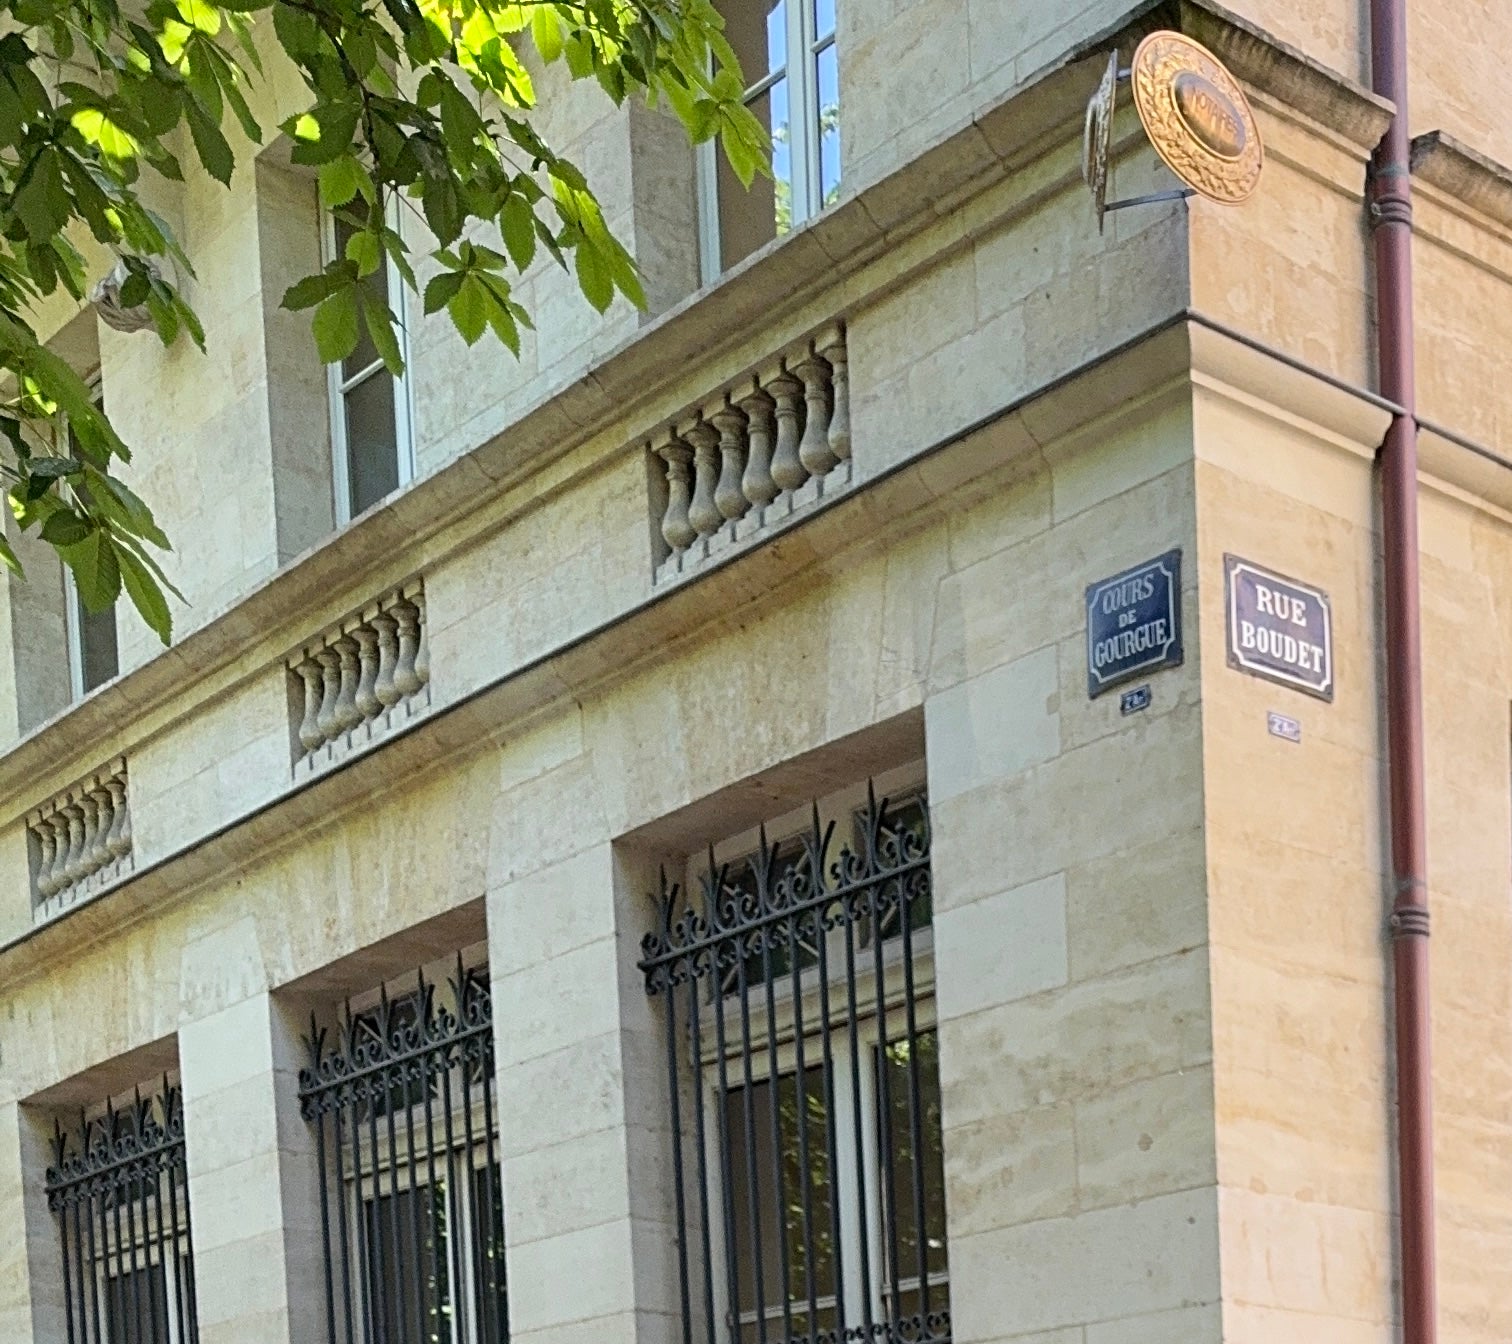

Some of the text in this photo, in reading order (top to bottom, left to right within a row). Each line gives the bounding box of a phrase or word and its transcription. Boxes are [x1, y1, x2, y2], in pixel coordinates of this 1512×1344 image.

[1103, 573, 1154, 615] COURS
[1255, 584, 1307, 628] RUE
[1118, 609, 1137, 628] DE
[1095, 618, 1167, 667] GOURGUE
[1241, 620, 1324, 673] BOUDET
